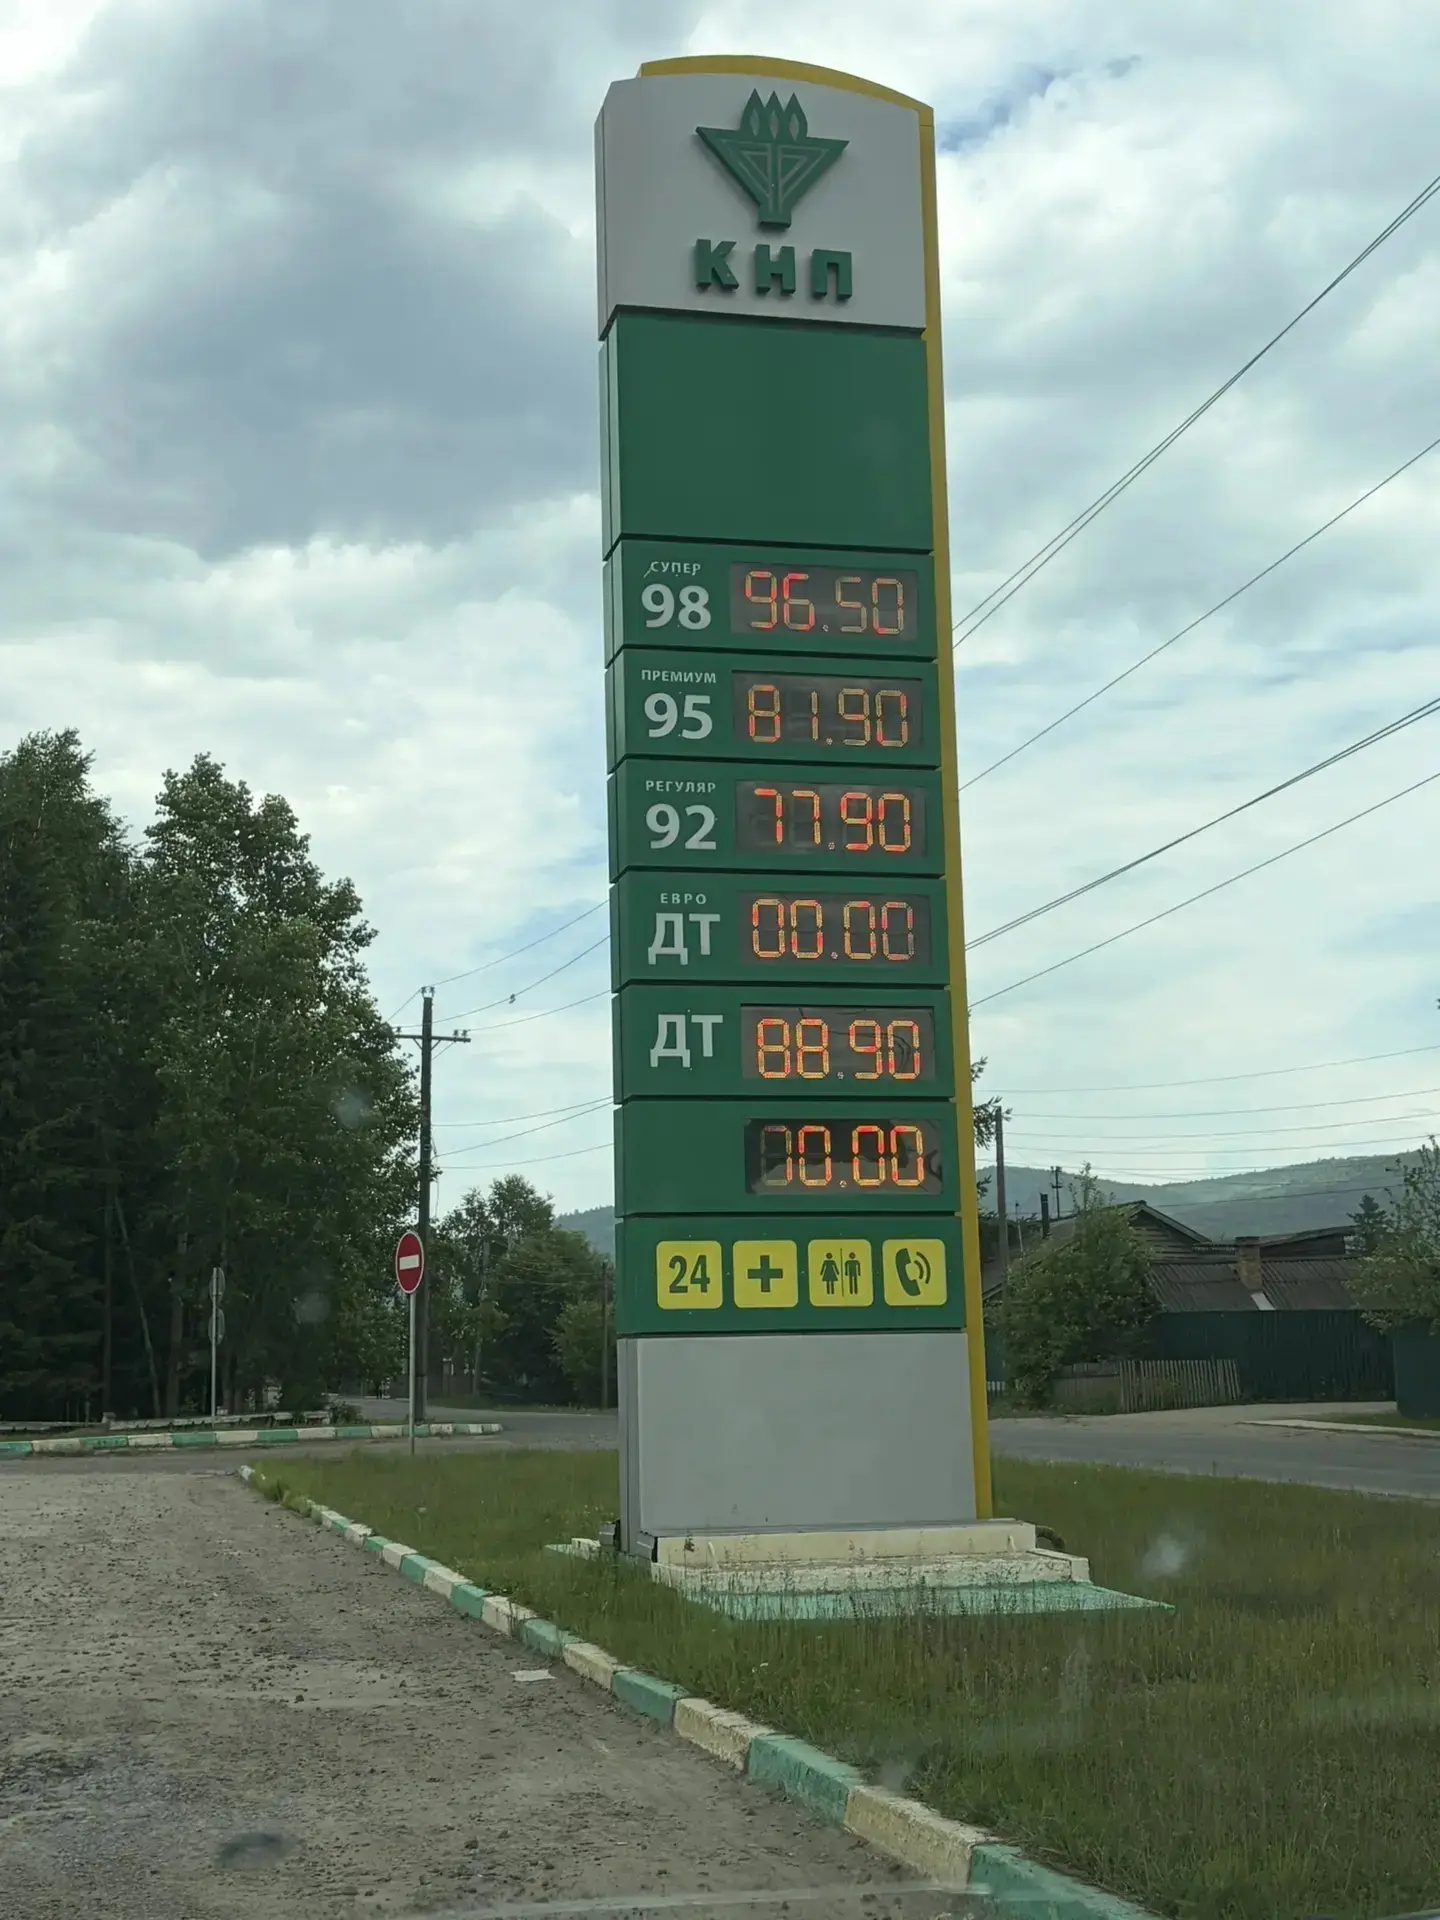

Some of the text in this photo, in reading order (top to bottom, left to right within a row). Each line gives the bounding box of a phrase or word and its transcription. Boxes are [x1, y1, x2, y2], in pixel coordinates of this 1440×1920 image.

[695, 239, 852, 300] КНП
[650, 561, 701, 574] СУПЕР
[641, 583, 712, 630] 98
[745, 570, 905, 635] 96.50
[641, 669, 716, 684] ПРЕМИУМ
[644, 692, 713, 740] 95
[748, 684, 908, 747] 81.90
[646, 780, 716, 793] РЕГУЛЯР
[646, 803, 716, 850] 92
[754, 788, 911, 851] 77.90
[660, 893, 707, 905] ЕВРО
[648, 913, 720, 965] ДТ
[752, 898, 914, 961] 00.00
[650, 1015, 723, 1068] ДТ
[756, 1018, 920, 1080] 88.90
[669, 1255, 710, 1293] 24
